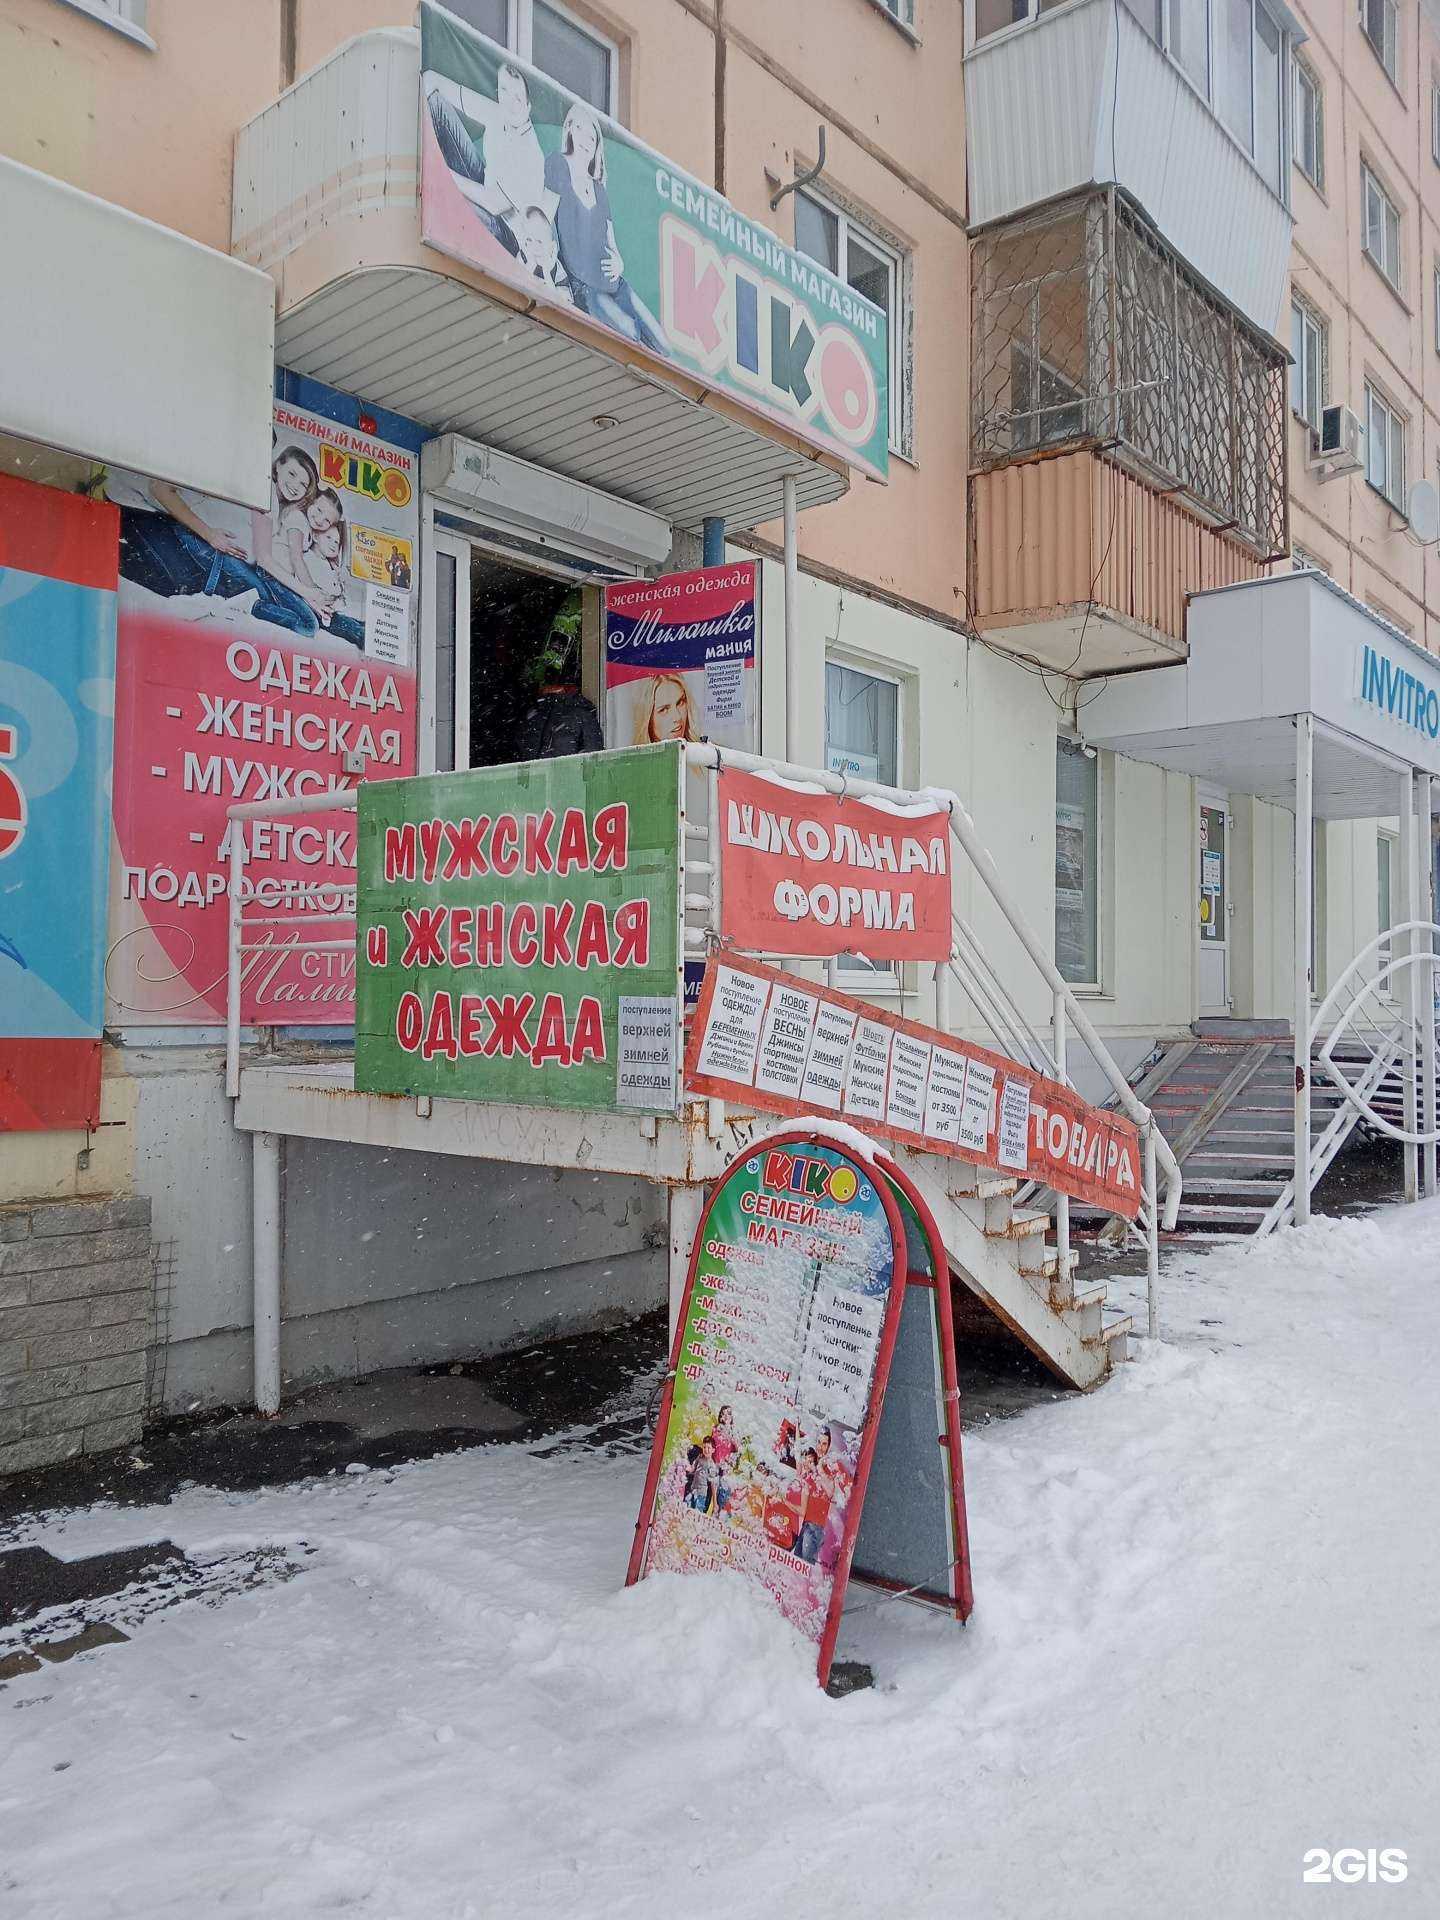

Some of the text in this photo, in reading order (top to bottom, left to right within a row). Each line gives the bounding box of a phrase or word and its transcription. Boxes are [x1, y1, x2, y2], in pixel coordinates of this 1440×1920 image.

[655, 168, 877, 338] СЕМЕЙНЫЙ МАГАЗИН
[663, 216, 876, 443] KIKO
[272, 407, 411, 469] ЕМЕЙНЫЙ МАГАЗИН
[320, 443, 411, 507] KIKO
[609, 571, 751, 607] женская одежда
[608, 600, 753, 650] Милашка
[705, 638, 752, 660] мания
[225, 640, 402, 713] ОДЕЖДА
[1361, 644, 1439, 739] INVITRO
[195, 692, 401, 765] ЖЕНСКАЯ
[183, 751, 357, 811] МУЖСК
[217, 818, 357, 868] ДЕТСК
[385, 802, 630, 884] МУЖСКАЯ
[773, 879, 916, 931] ФОРМА
[367, 898, 650, 969] и ЖЕНСКАЯ
[722, 997, 757, 1016] ОДЕЖДЫ
[731, 975, 755, 991] Новое
[780, 993, 809, 1012] НОВОЕ
[396, 991, 607, 1068] ОДЕЖДА
[622, 1006, 672, 1015] поступление
[711, 1020, 757, 1040] БЕРЕМЕННЫХ
[773, 1018, 807, 1038] ВЕСНЫ
[623, 1047, 669, 1062] зимней
[768, 1034, 804, 1052] Джинсы
[620, 1073, 671, 1087] одежды
[936, 1120, 950, 1132] руб
[940, 1102, 957, 1116] 3500
[763, 1150, 859, 1204] KIKO
[817, 1312, 873, 1338] поступление
